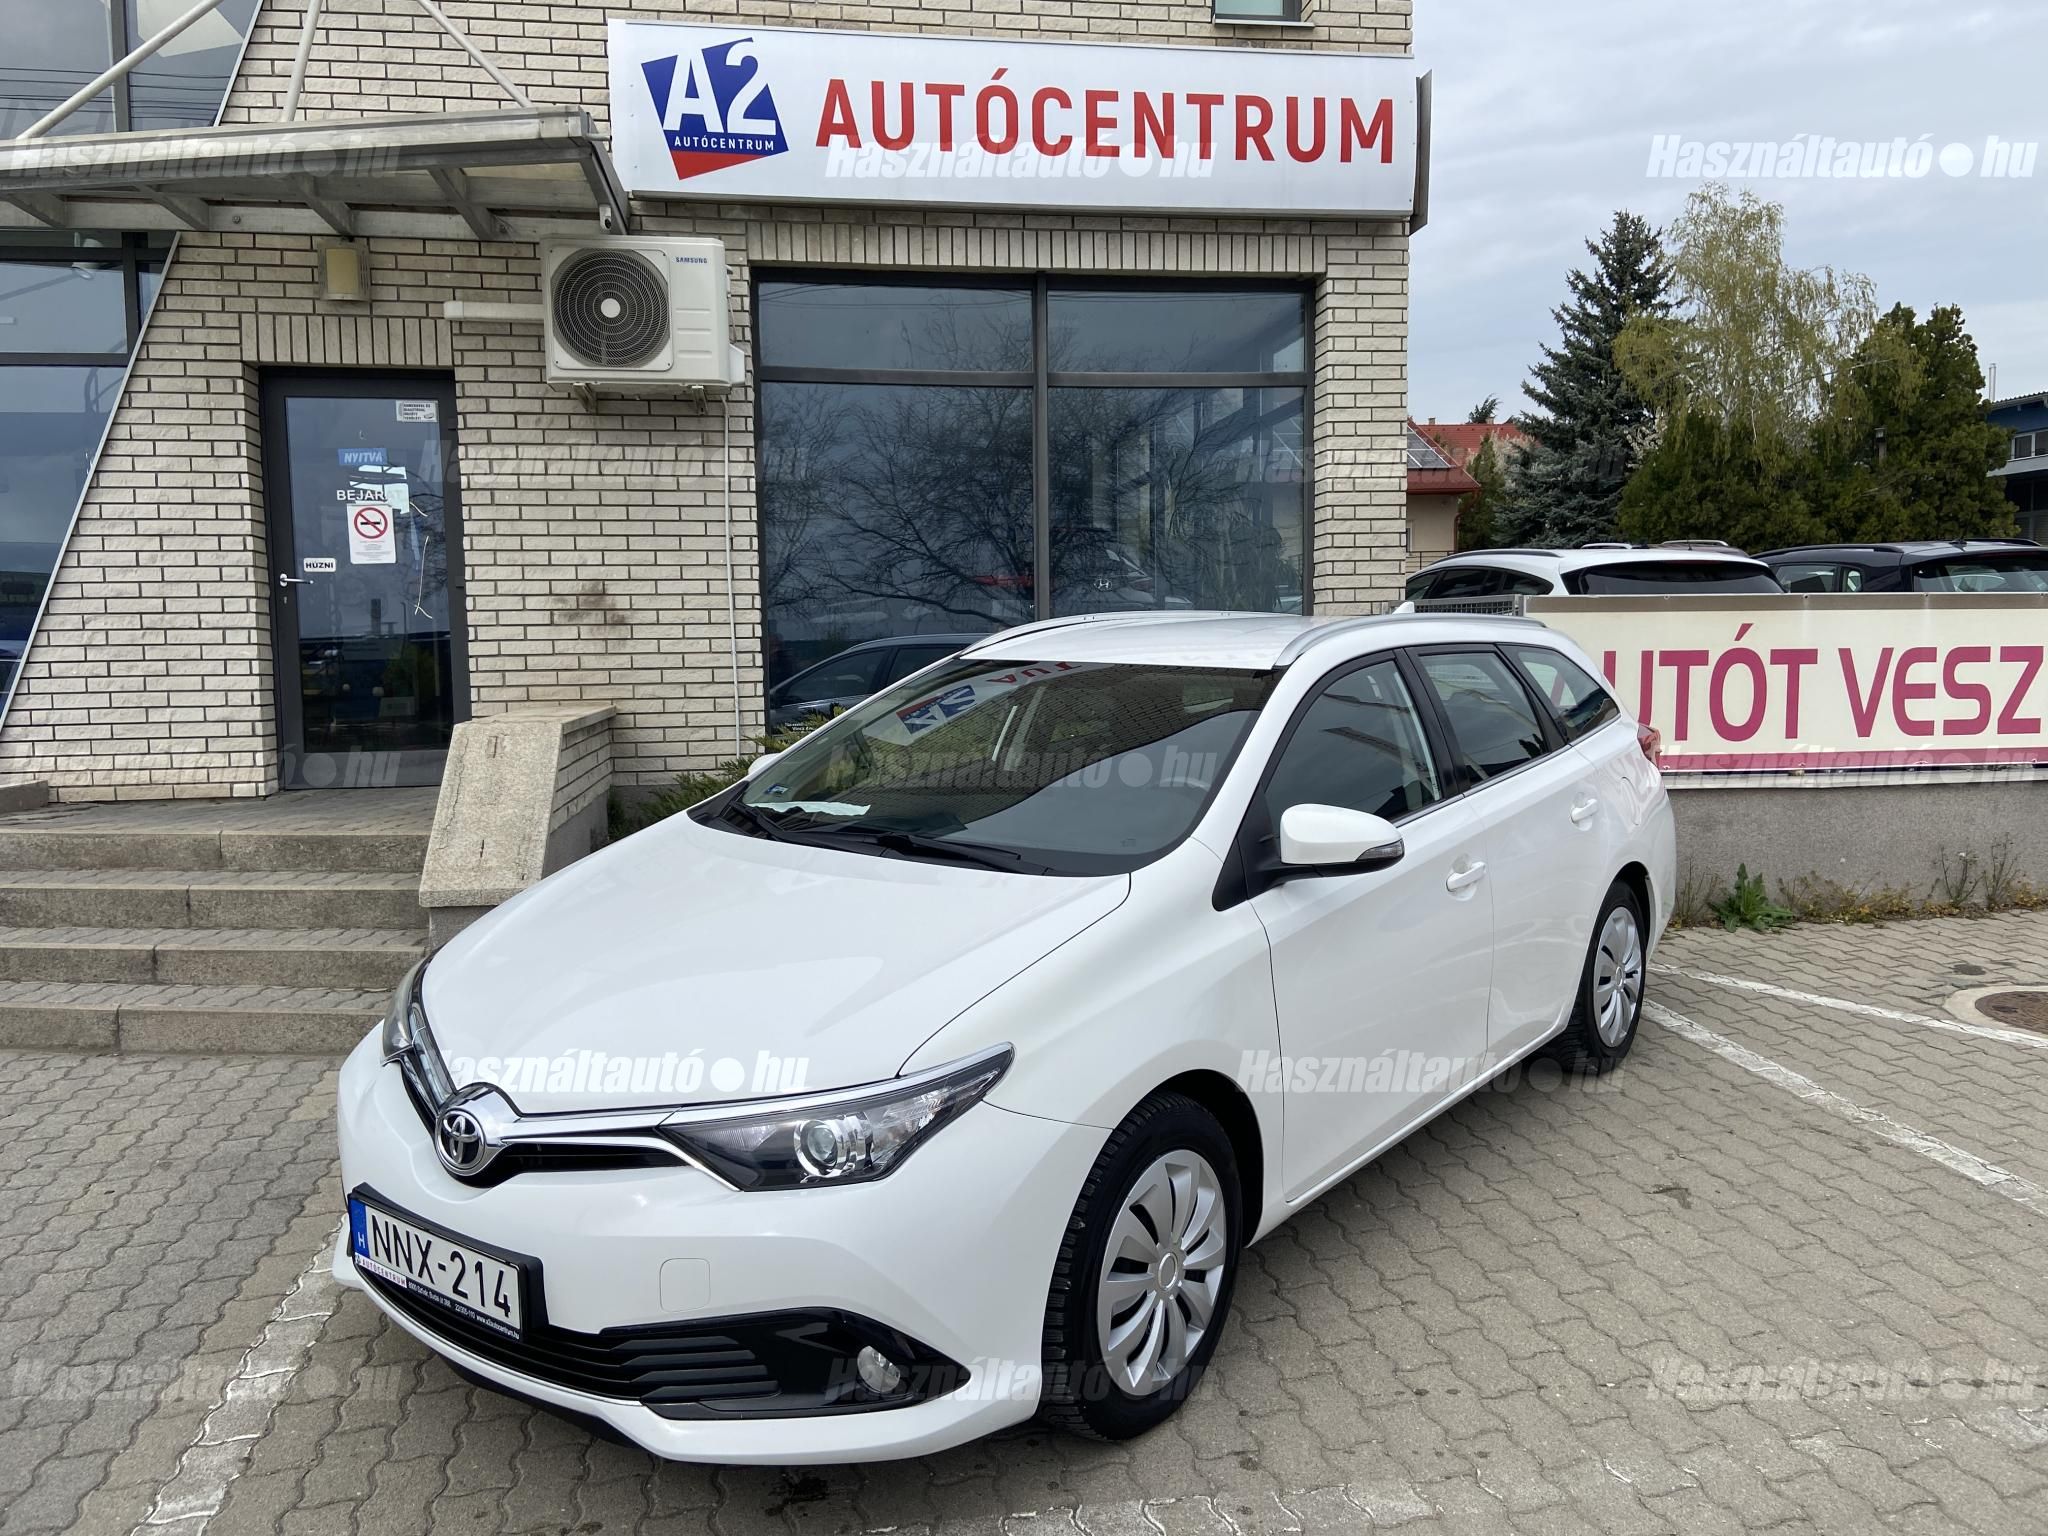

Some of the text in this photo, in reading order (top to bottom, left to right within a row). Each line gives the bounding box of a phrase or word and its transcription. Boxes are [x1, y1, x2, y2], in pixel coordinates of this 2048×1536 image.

[662, 40, 776, 136] A2
[815, 67, 1394, 165] AUTÓCENTRUM
[674, 135, 774, 151] AUTÓCENTRUM
[675, 256, 708, 264] SAMSUNG
[344, 451, 383, 463] NYITVA
[1604, 623, 2045, 742] UTÓT VESZ
[357, 1232, 366, 1248] H
[371, 1214, 511, 1318] NNX-214
